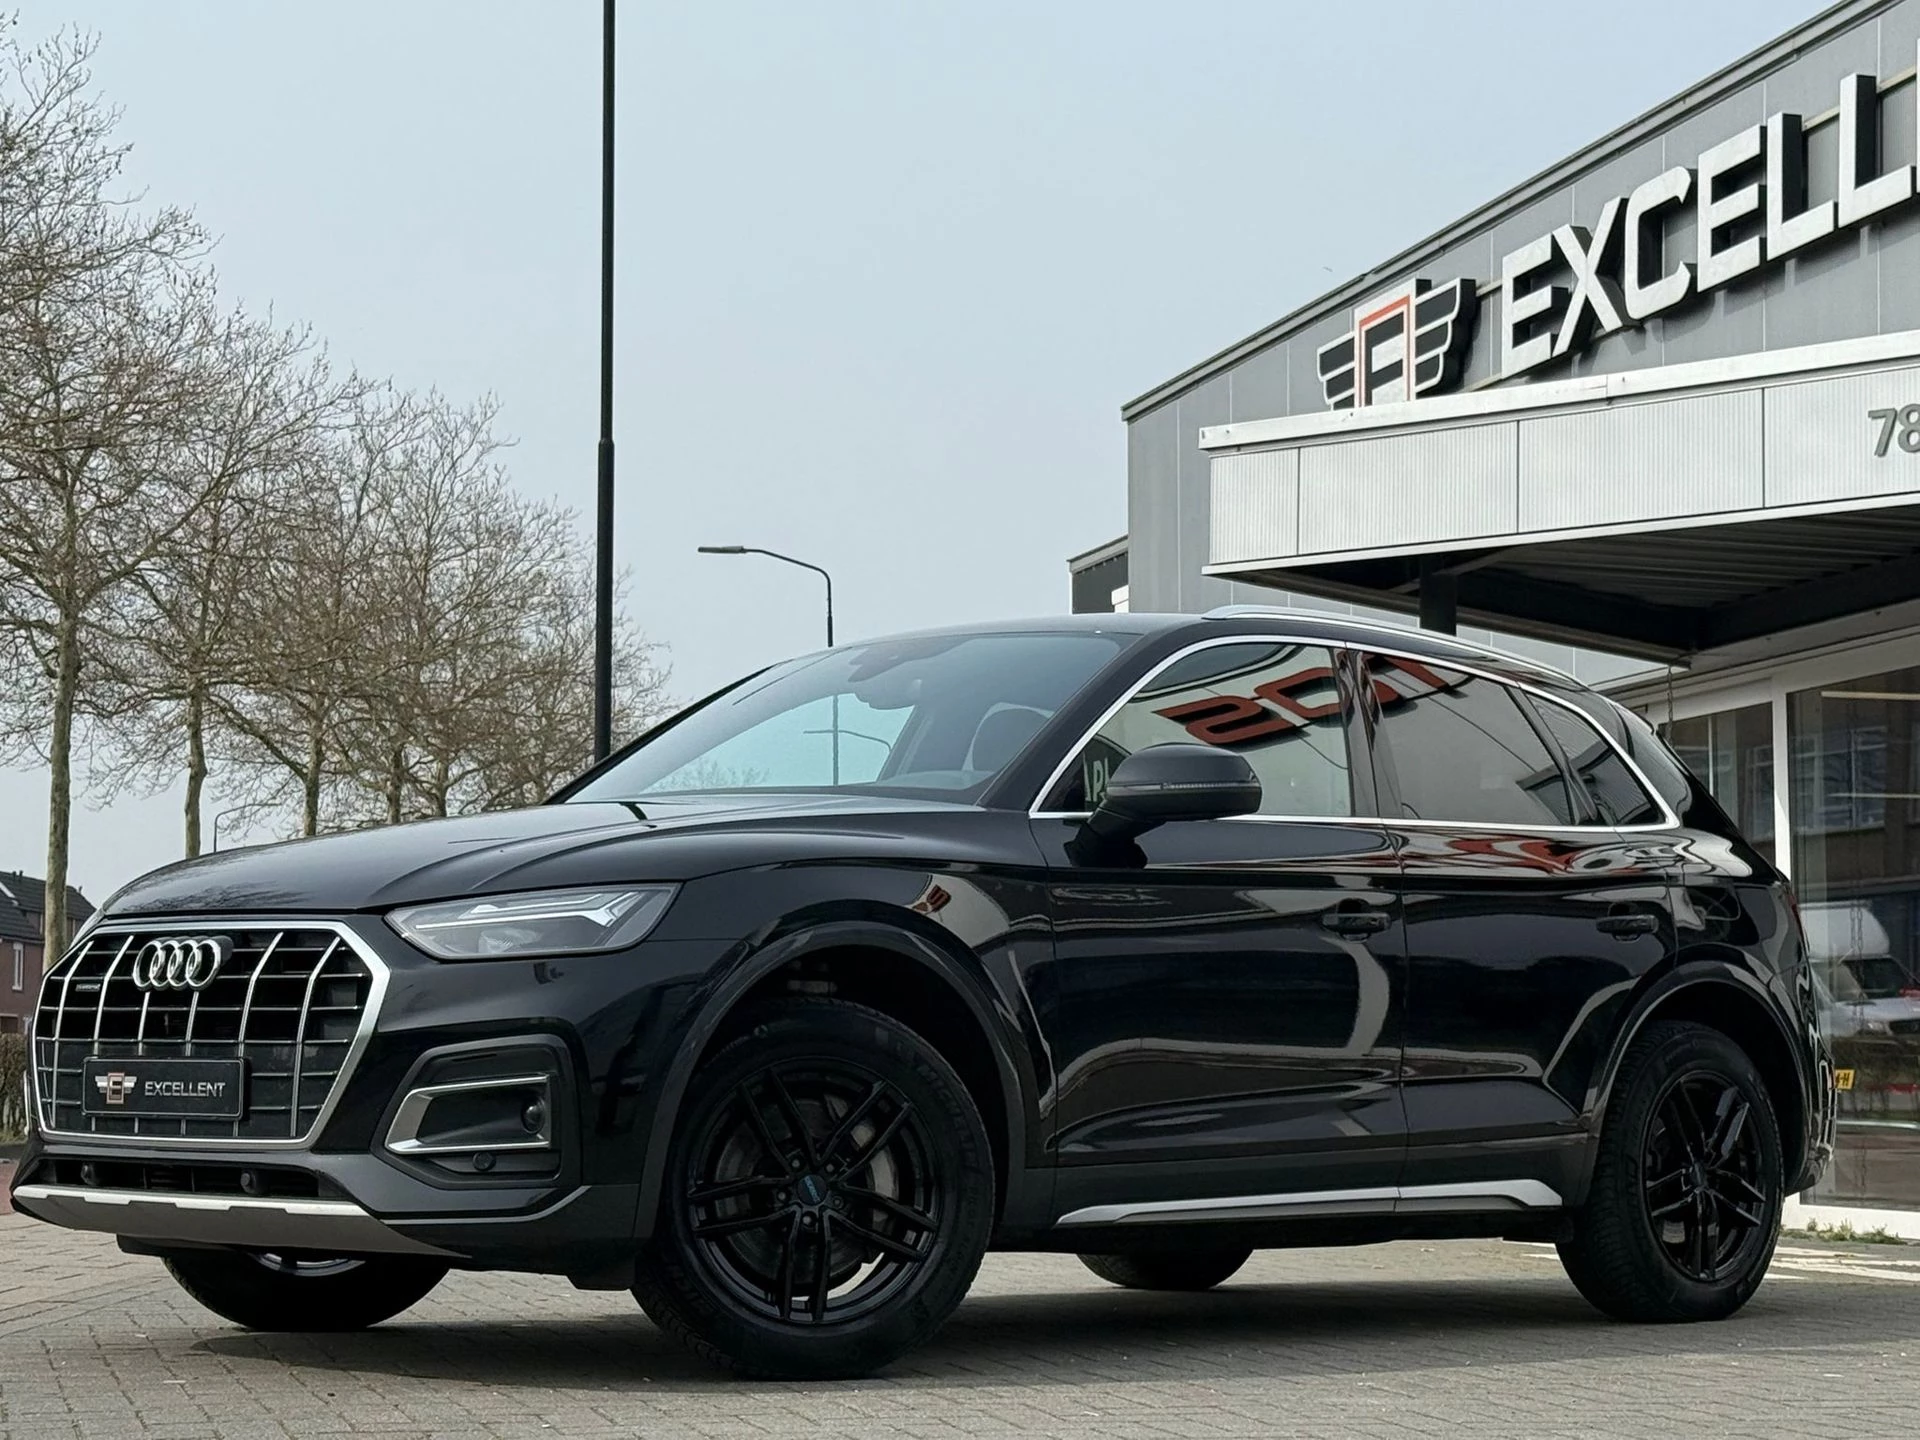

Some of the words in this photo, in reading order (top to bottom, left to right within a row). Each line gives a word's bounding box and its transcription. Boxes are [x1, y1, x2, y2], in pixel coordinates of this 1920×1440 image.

[1502, 38, 1920, 381] EXCELL
[1867, 403, 1920, 457] 78
[144, 1081, 226, 1098] EXCELLENT
